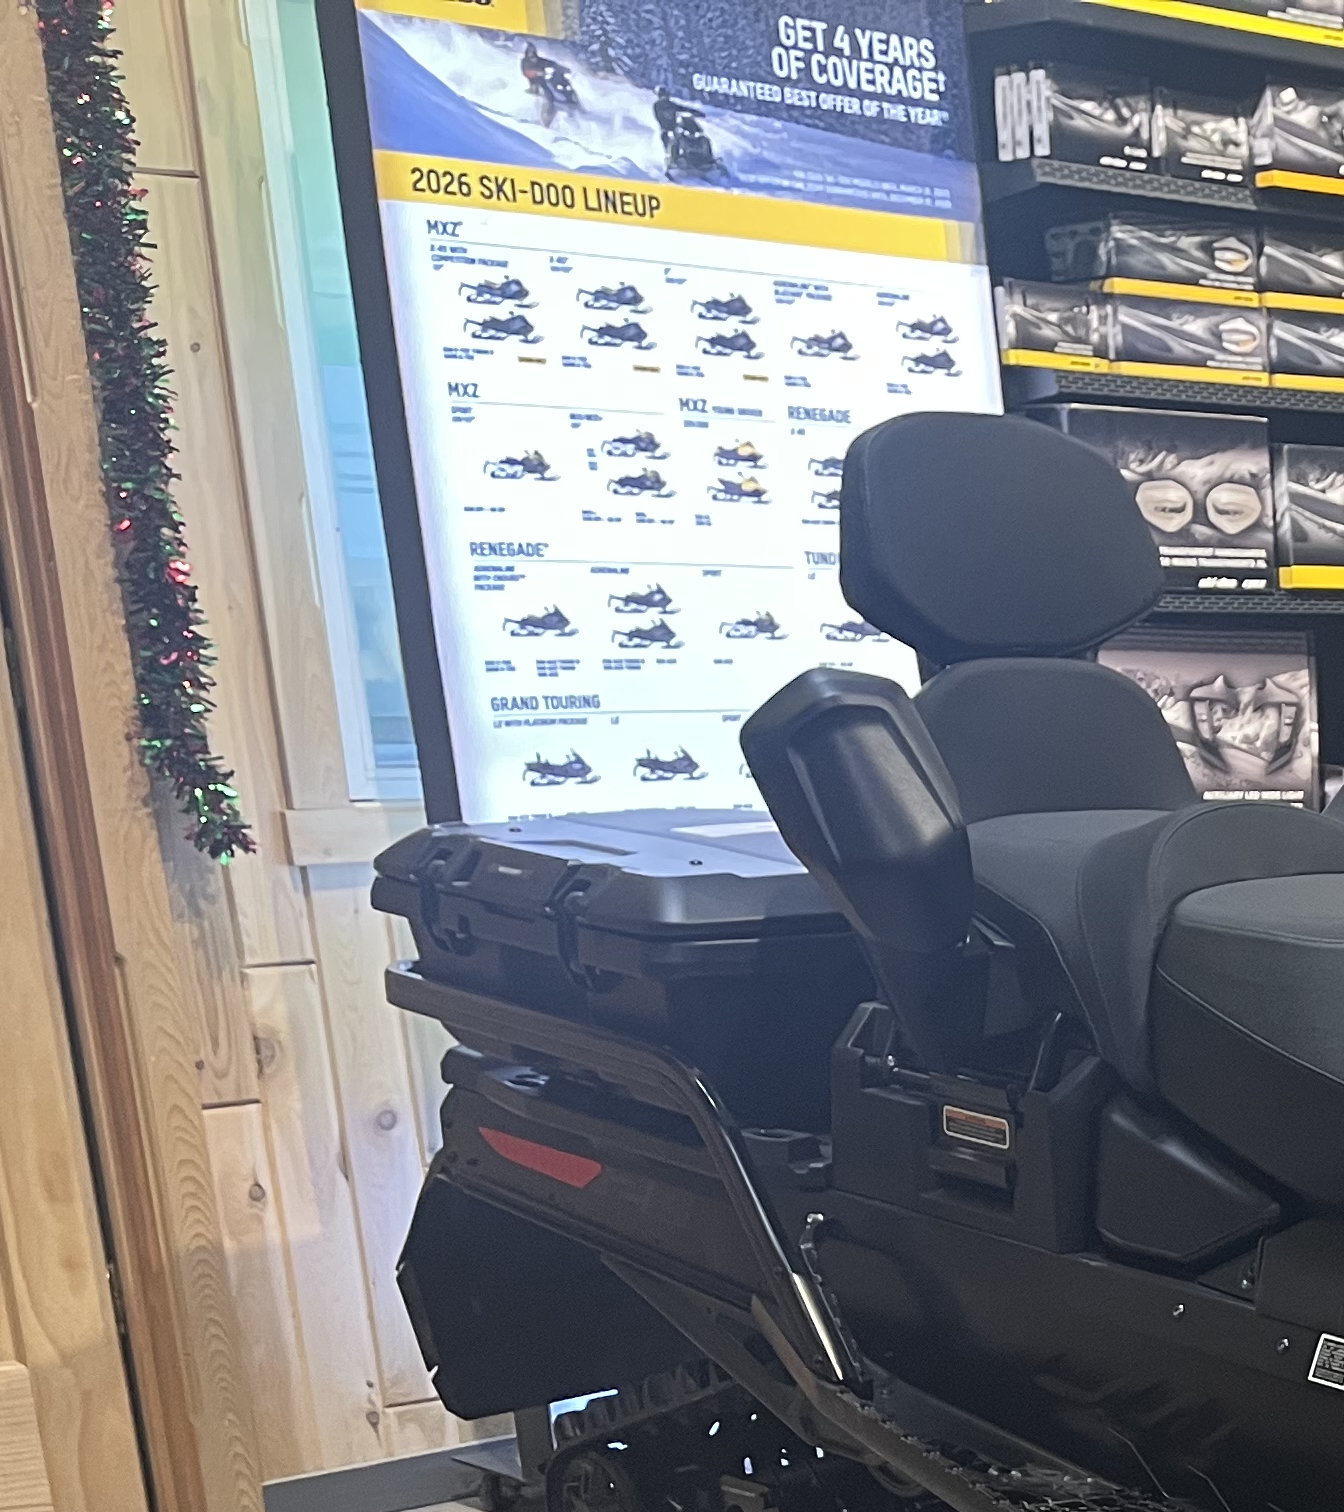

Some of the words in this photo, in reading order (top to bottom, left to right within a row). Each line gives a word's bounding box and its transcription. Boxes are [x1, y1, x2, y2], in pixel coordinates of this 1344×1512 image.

[777, 15, 827, 51] GET
[833, 24, 850, 56] 4
[854, 27, 937, 69] YEARS
[771, 46, 806, 80] OF
[692, 73, 782, 103] GUARANTEED
[783, 87, 818, 108] BEST
[818, 92, 862, 115] OFFER
[862, 99, 884, 118] OF
[411, 167, 472, 197] 2026
[479, 175, 576, 209] SKI-DOO
[583, 187, 661, 218] LINEUP
[787, 405, 852, 424] RENEGADE
[804, 550, 840, 566] TUND
[490, 695, 539, 712] GRAND
[542, 693, 600, 711] TOURING
